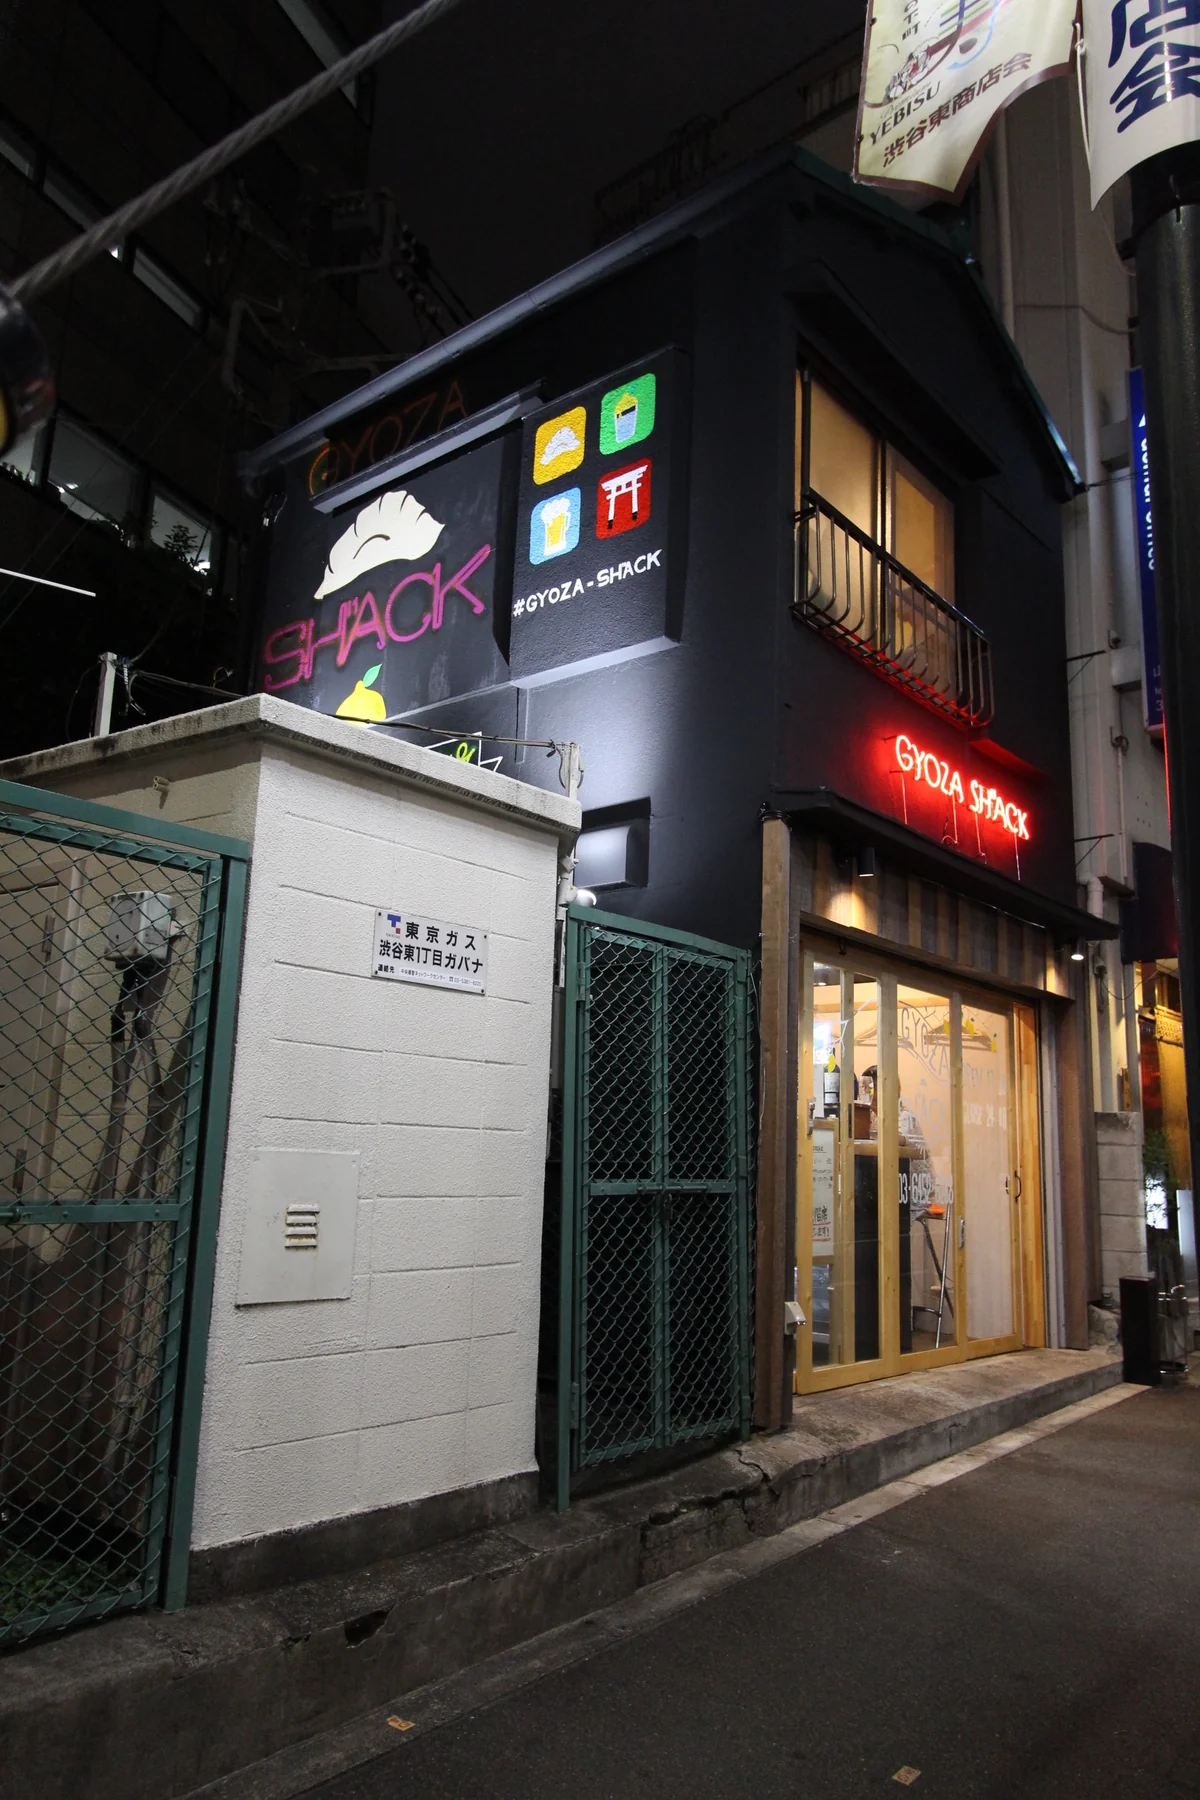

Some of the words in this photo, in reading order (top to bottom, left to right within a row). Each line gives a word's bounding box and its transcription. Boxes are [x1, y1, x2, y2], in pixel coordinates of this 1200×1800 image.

[870, 80, 941, 147] YEBISU
[883, 52, 1032, 168] 渋谷東商店会
[309, 379, 468, 496] GYOZA
[264, 544, 491, 692] SHACK
[896, 735, 964, 803] GYOZA
[969, 779, 1030, 840] SHACK
[379, 939, 484, 974] 渋谷東1丁目ガバナ
[405, 921, 476, 951] 東京ガス
[901, 1007, 950, 1076] GYOZA
